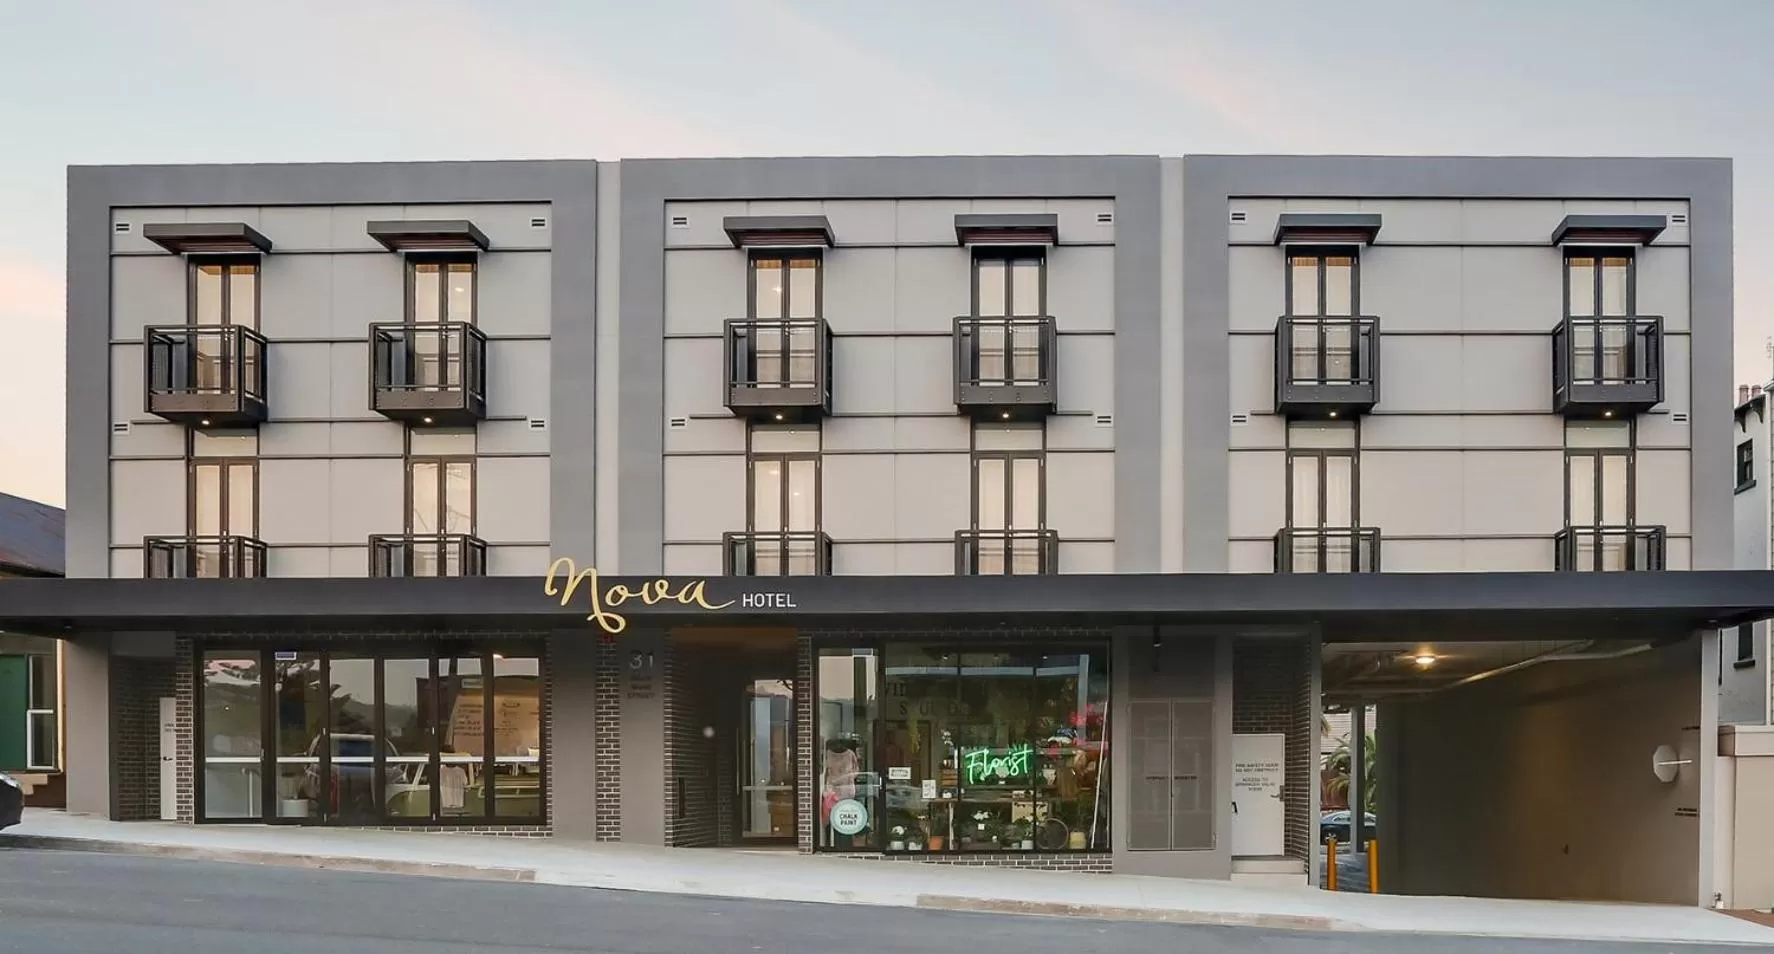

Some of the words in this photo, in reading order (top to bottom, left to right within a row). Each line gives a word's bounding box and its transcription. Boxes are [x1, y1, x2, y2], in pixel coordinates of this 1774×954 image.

[544, 557, 736, 634] Nova
[742, 593, 797, 608] HOTEL
[628, 650, 654, 669] 31
[965, 744, 1033, 784] Florist
